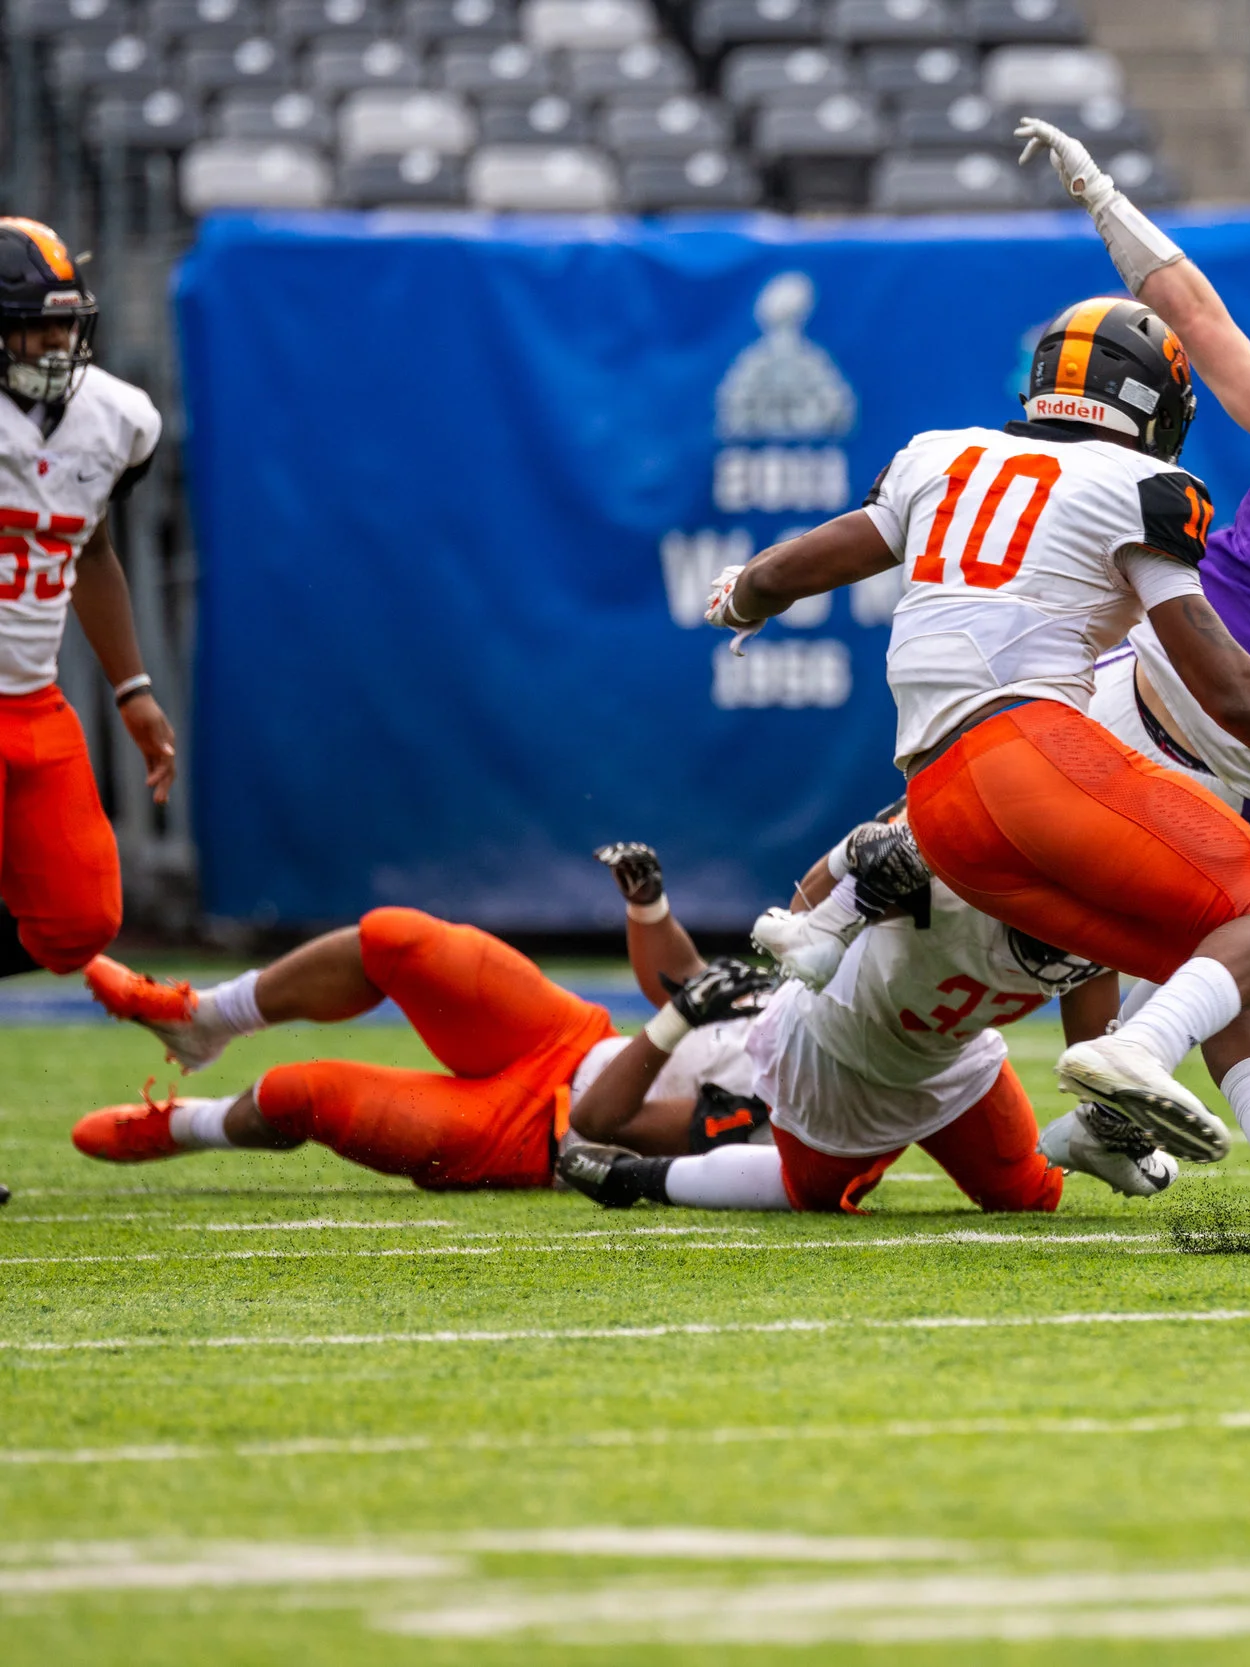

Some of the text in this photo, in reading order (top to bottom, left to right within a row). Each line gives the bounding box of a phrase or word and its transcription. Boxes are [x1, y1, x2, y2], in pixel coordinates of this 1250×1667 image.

[1036, 400, 1105, 421] Riddell
[0, 507, 86, 600] 55
[911, 446, 1062, 589] 10
